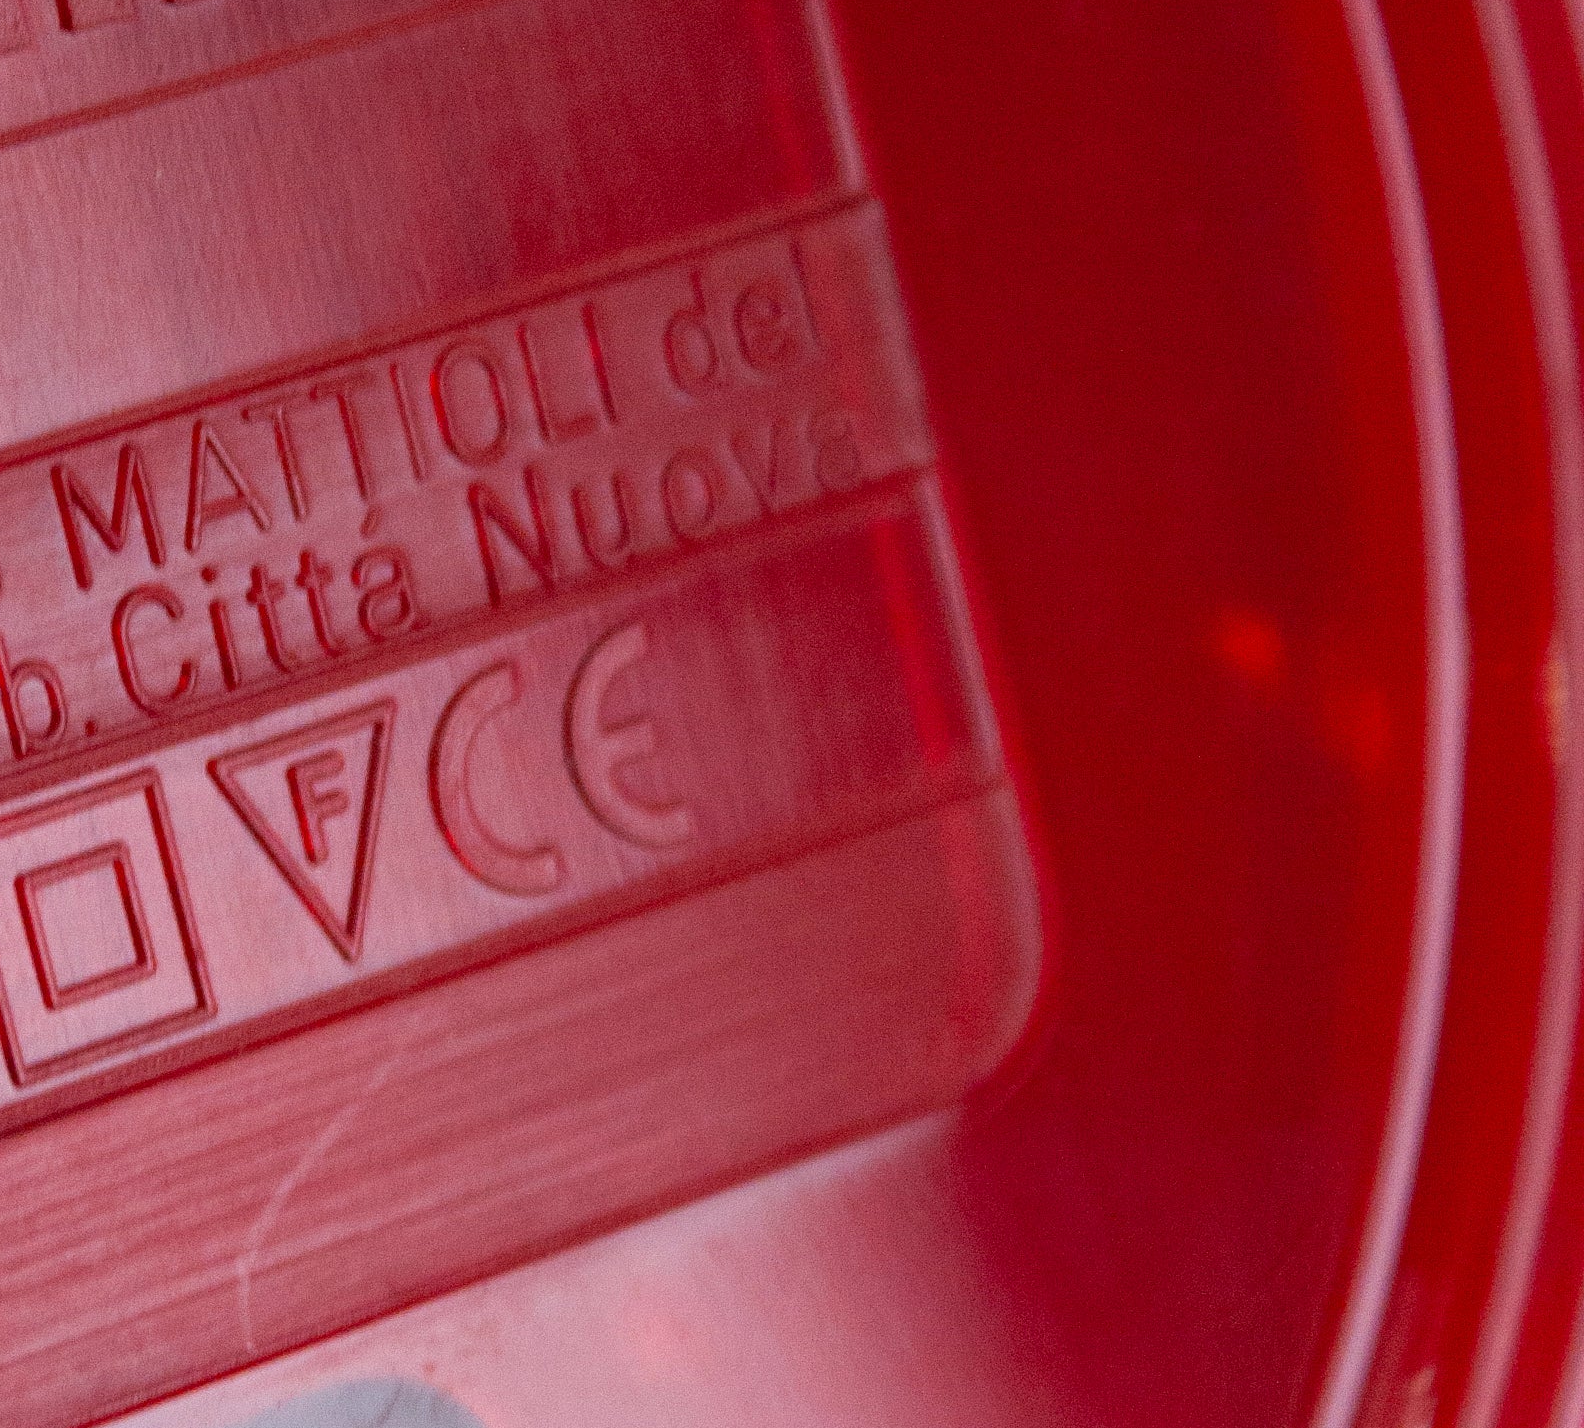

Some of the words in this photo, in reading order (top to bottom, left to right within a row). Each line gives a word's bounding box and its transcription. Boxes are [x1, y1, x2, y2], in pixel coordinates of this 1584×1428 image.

[50, 301, 618, 591] MATTIOLI
[664, 239, 818, 399] del
[466, 409, 863, 611] Nuova
